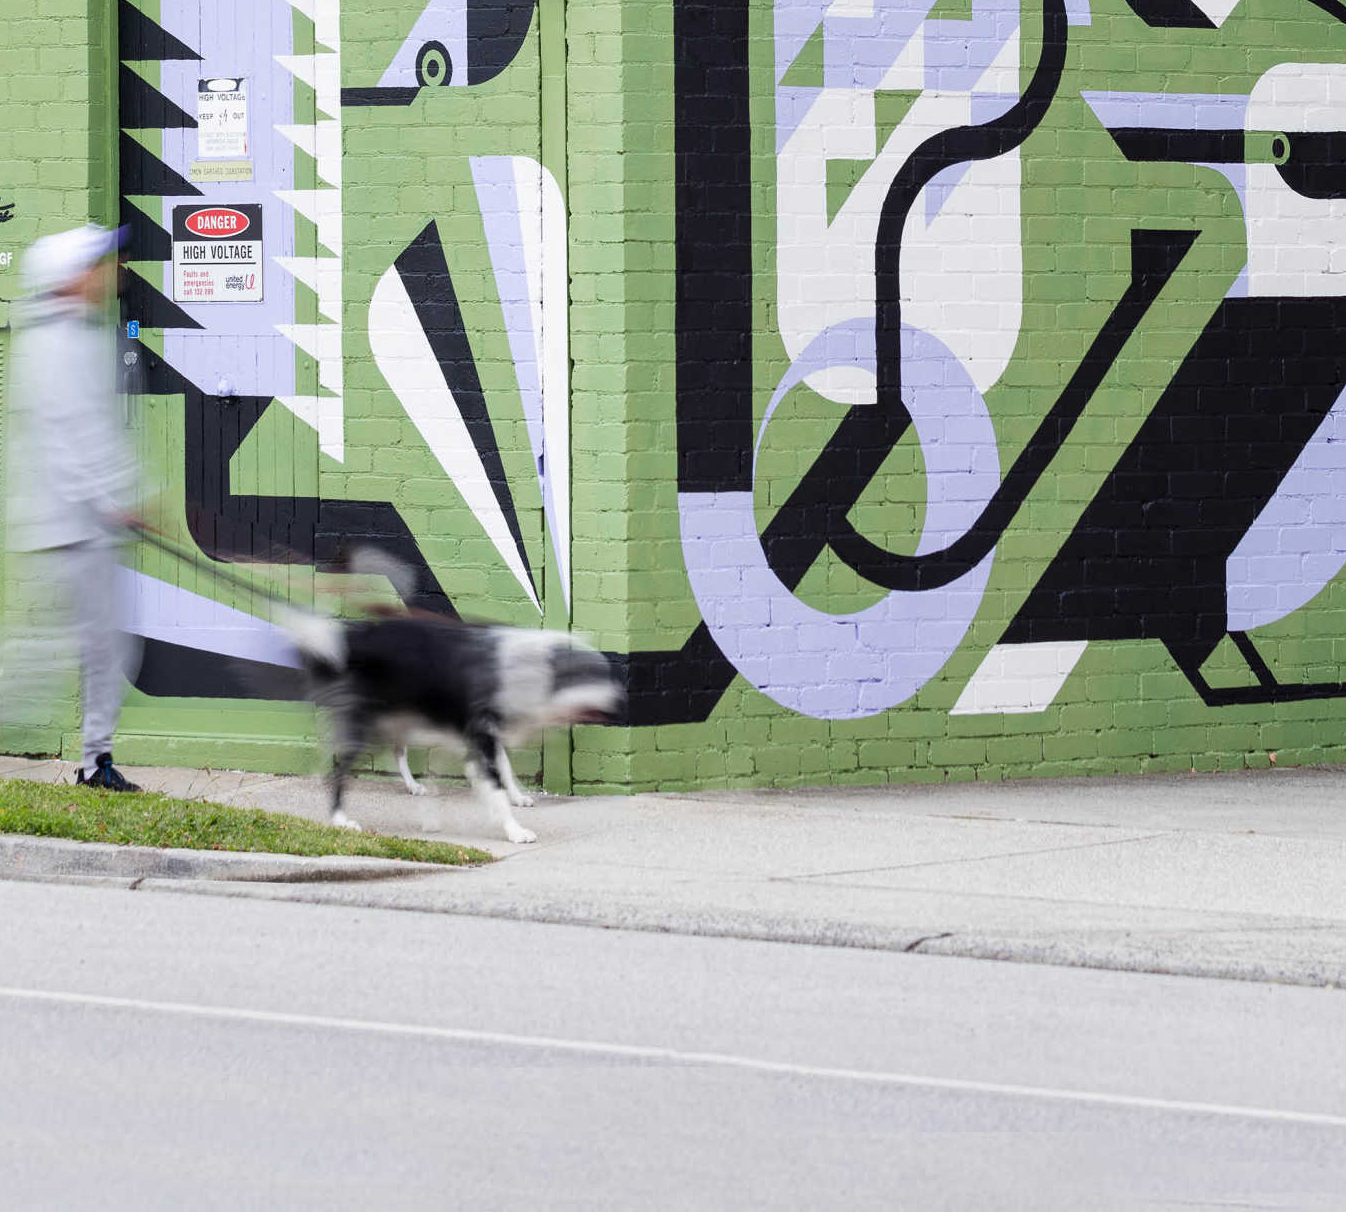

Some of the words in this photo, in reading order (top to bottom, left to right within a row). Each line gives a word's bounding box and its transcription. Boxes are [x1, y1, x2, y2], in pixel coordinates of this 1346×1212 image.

[197, 215, 237, 229] DANGER
[183, 246, 205, 259] HIGH
[211, 245, 252, 259] VOLTAGE
[226, 275, 243, 283] united
[226, 282, 244, 291] energy
